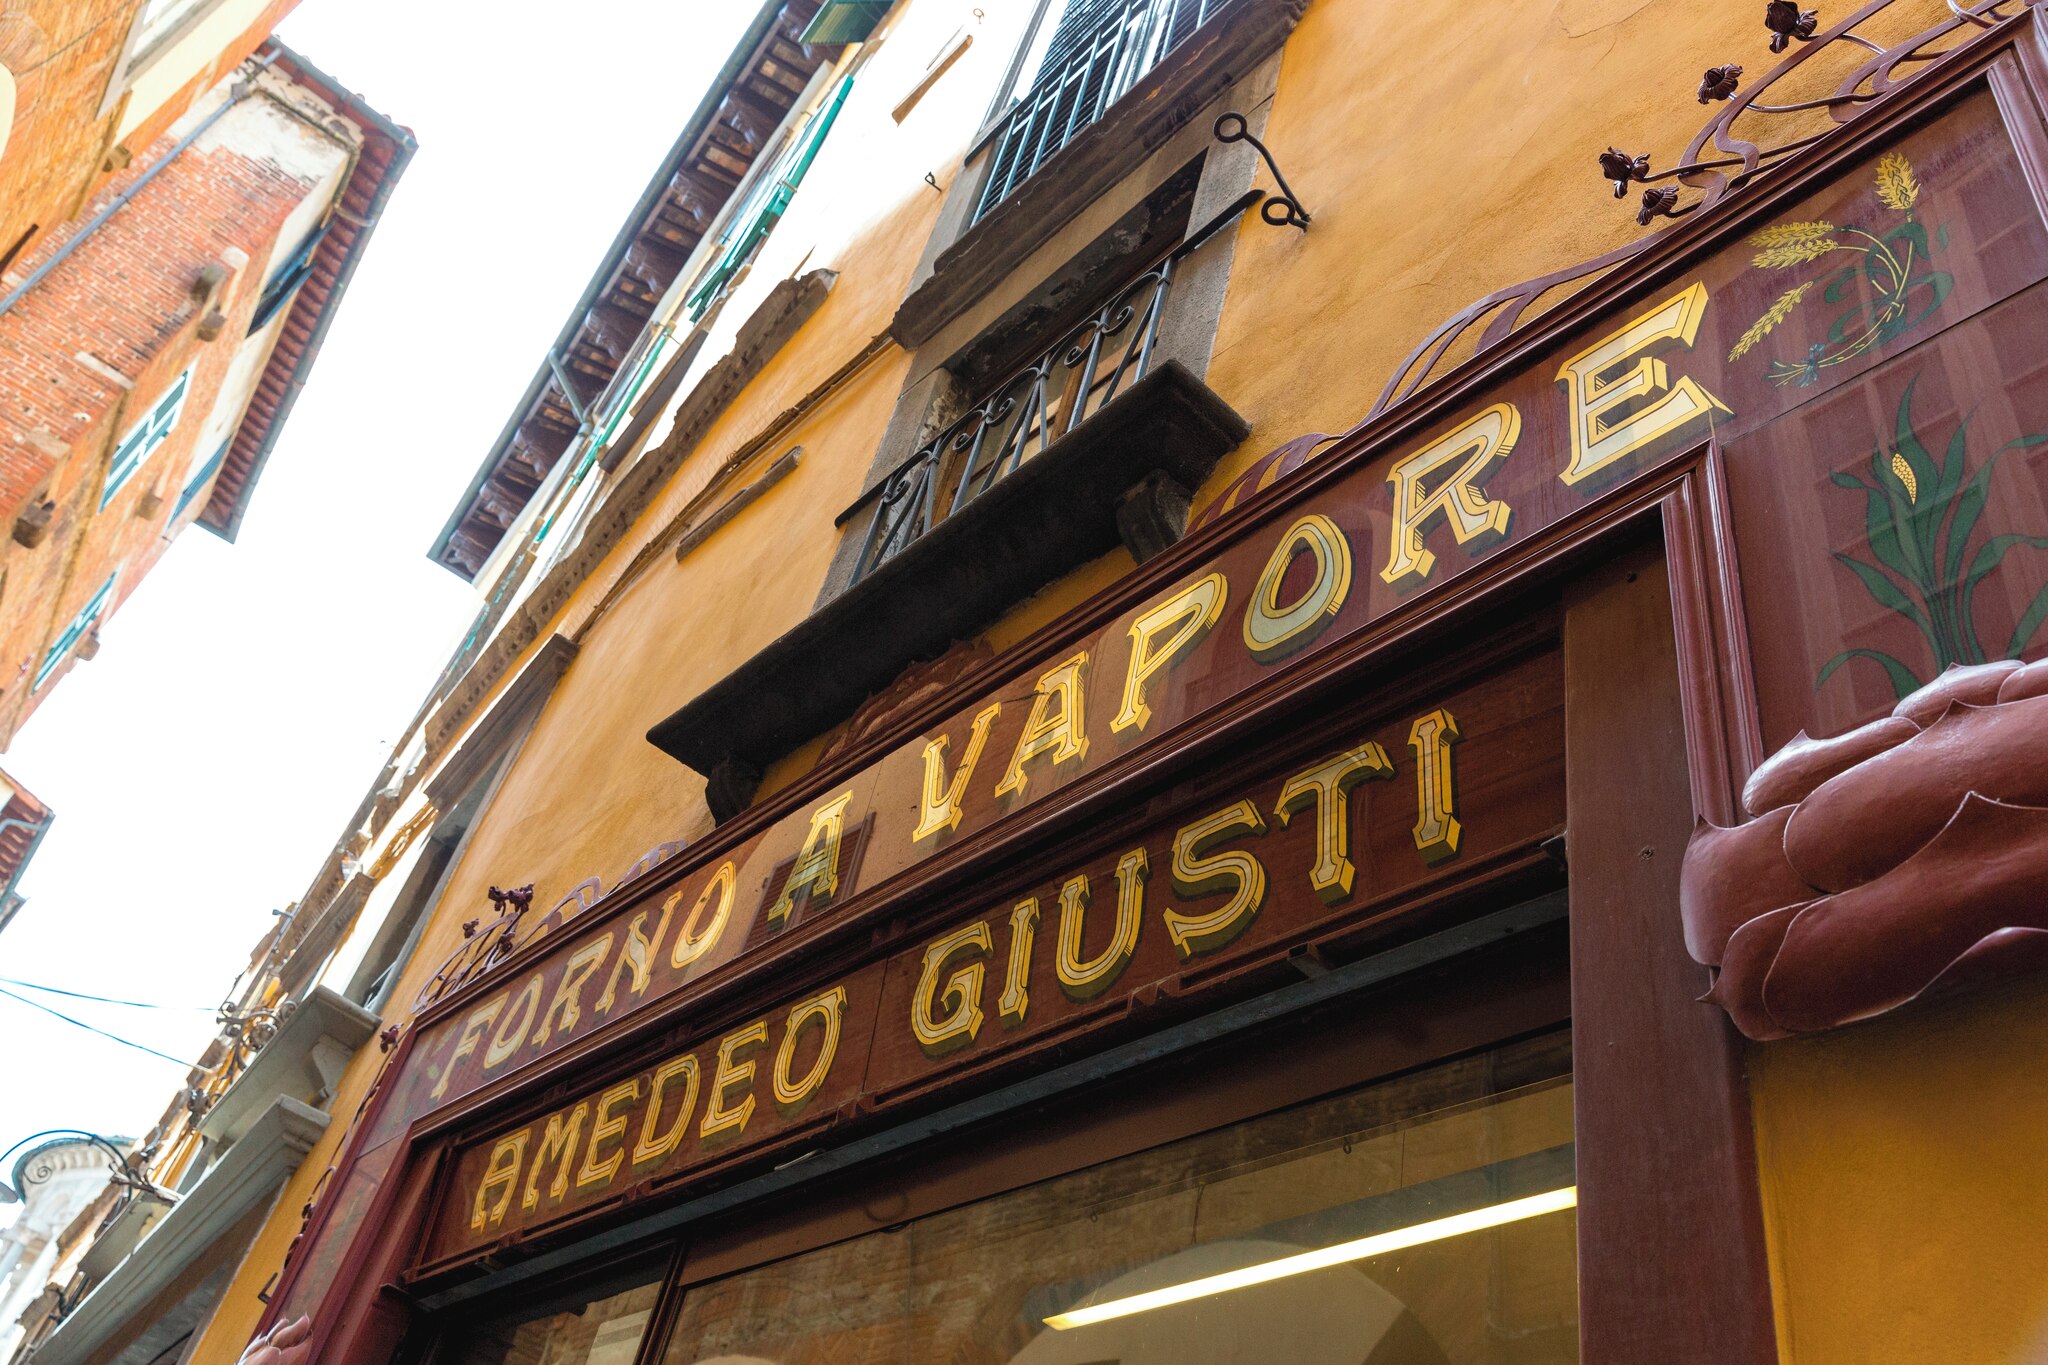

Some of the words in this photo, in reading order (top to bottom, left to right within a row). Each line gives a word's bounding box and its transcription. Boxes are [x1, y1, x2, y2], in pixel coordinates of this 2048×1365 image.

[431, 861, 736, 1099] FORNO
[768, 790, 854, 921] A
[912, 280, 1736, 842] VAPORE
[470, 986, 847, 1230] AMEDEO
[911, 707, 1460, 1046] GIUSTI
